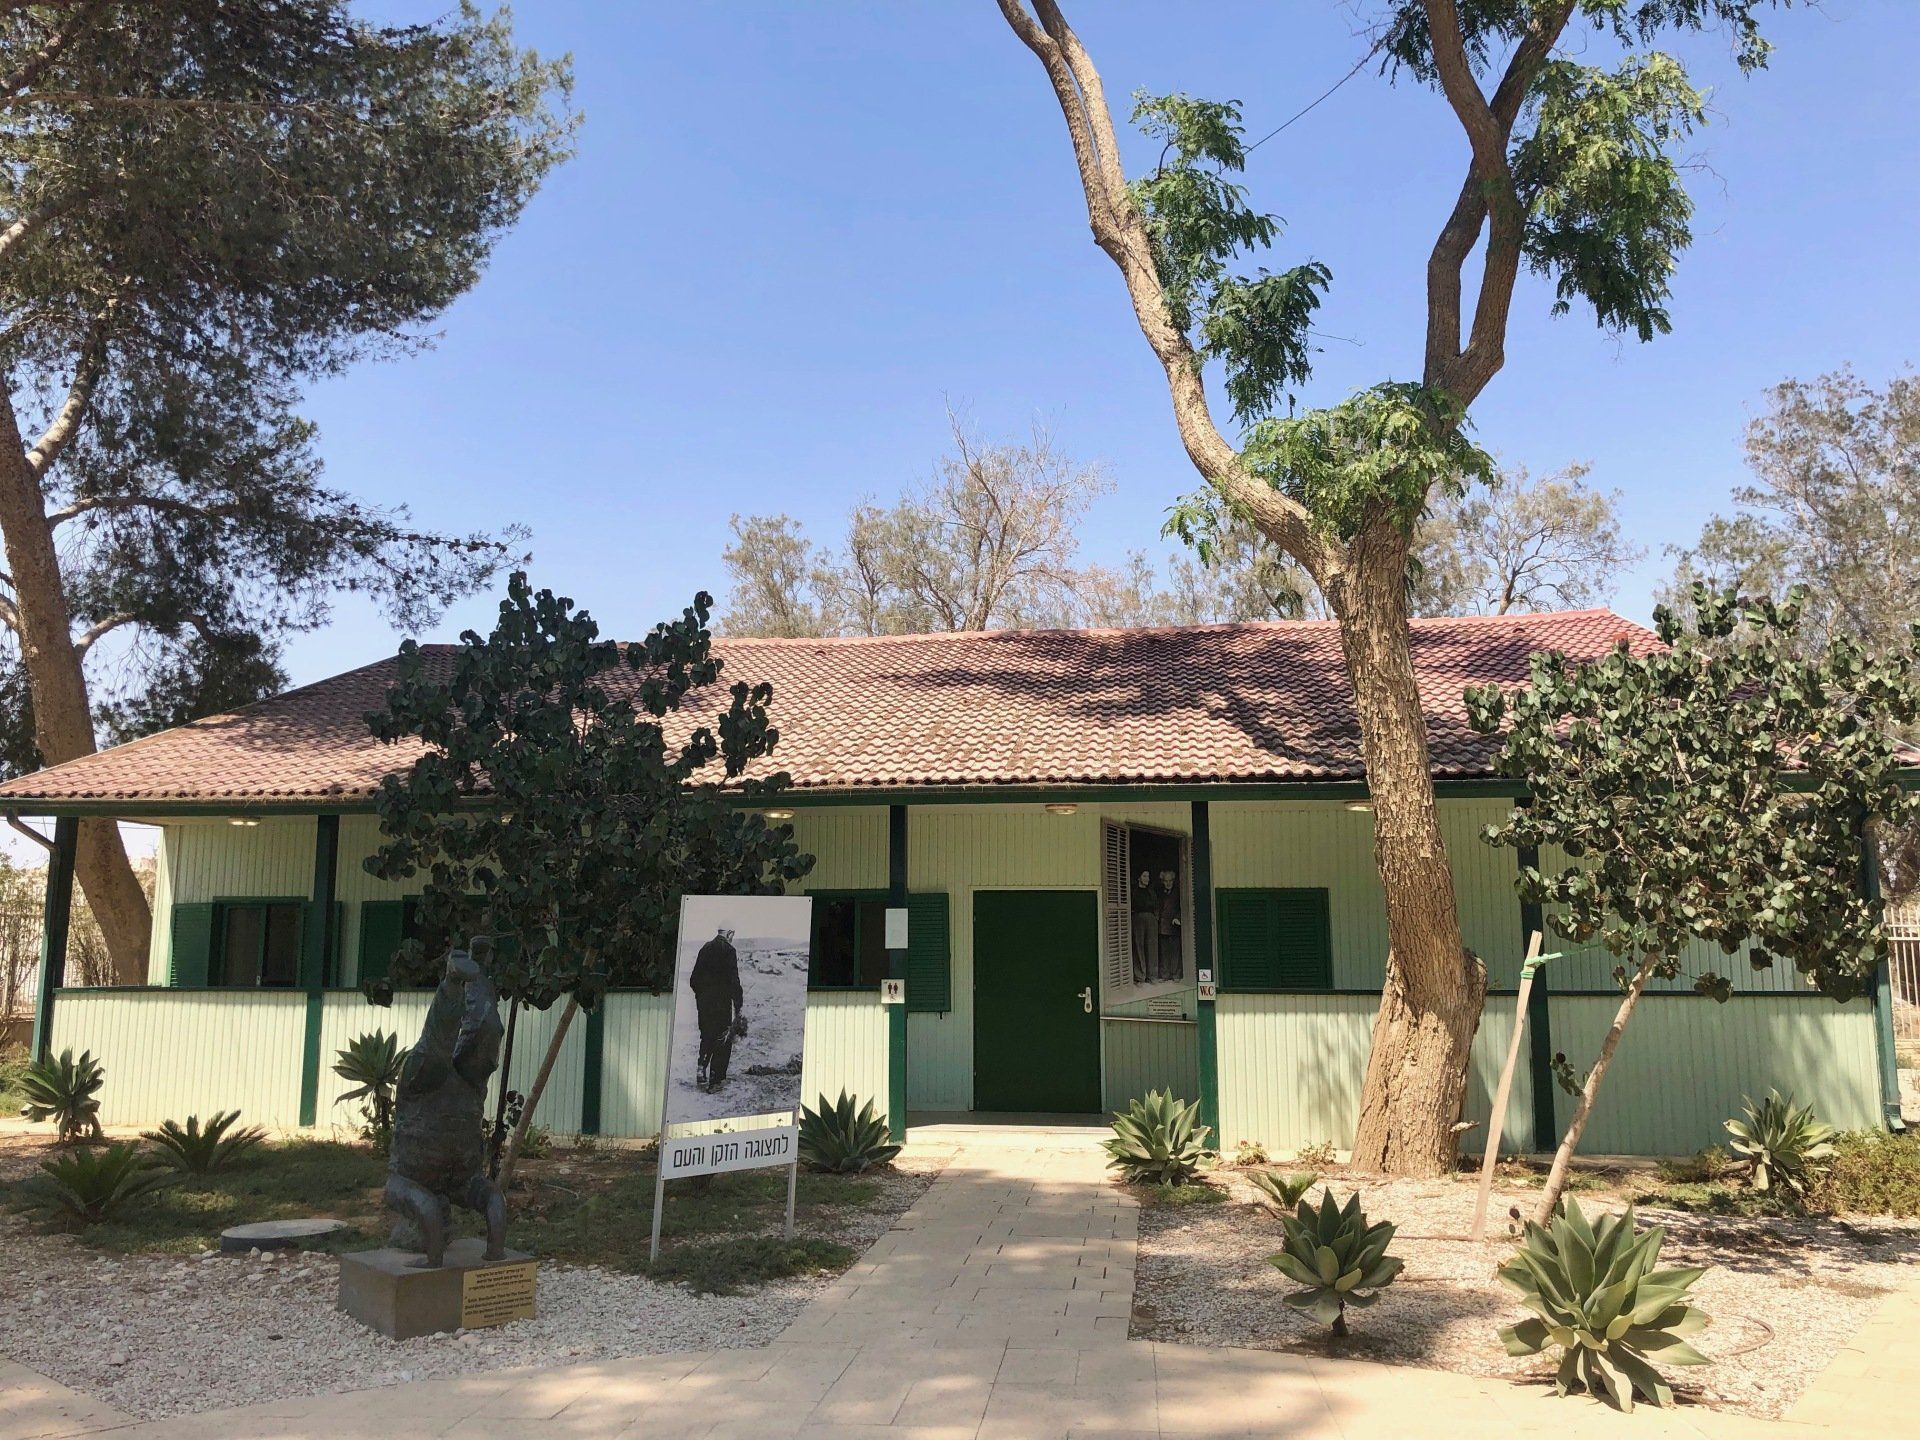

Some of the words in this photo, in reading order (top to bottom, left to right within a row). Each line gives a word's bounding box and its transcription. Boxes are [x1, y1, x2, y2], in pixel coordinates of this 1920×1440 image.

[1200, 986, 1214, 996] W.C
[673, 1146, 705, 1168] והעם
[710, 1142, 739, 1167] הזקן
[744, 1134, 789, 1158] לתצוגה
